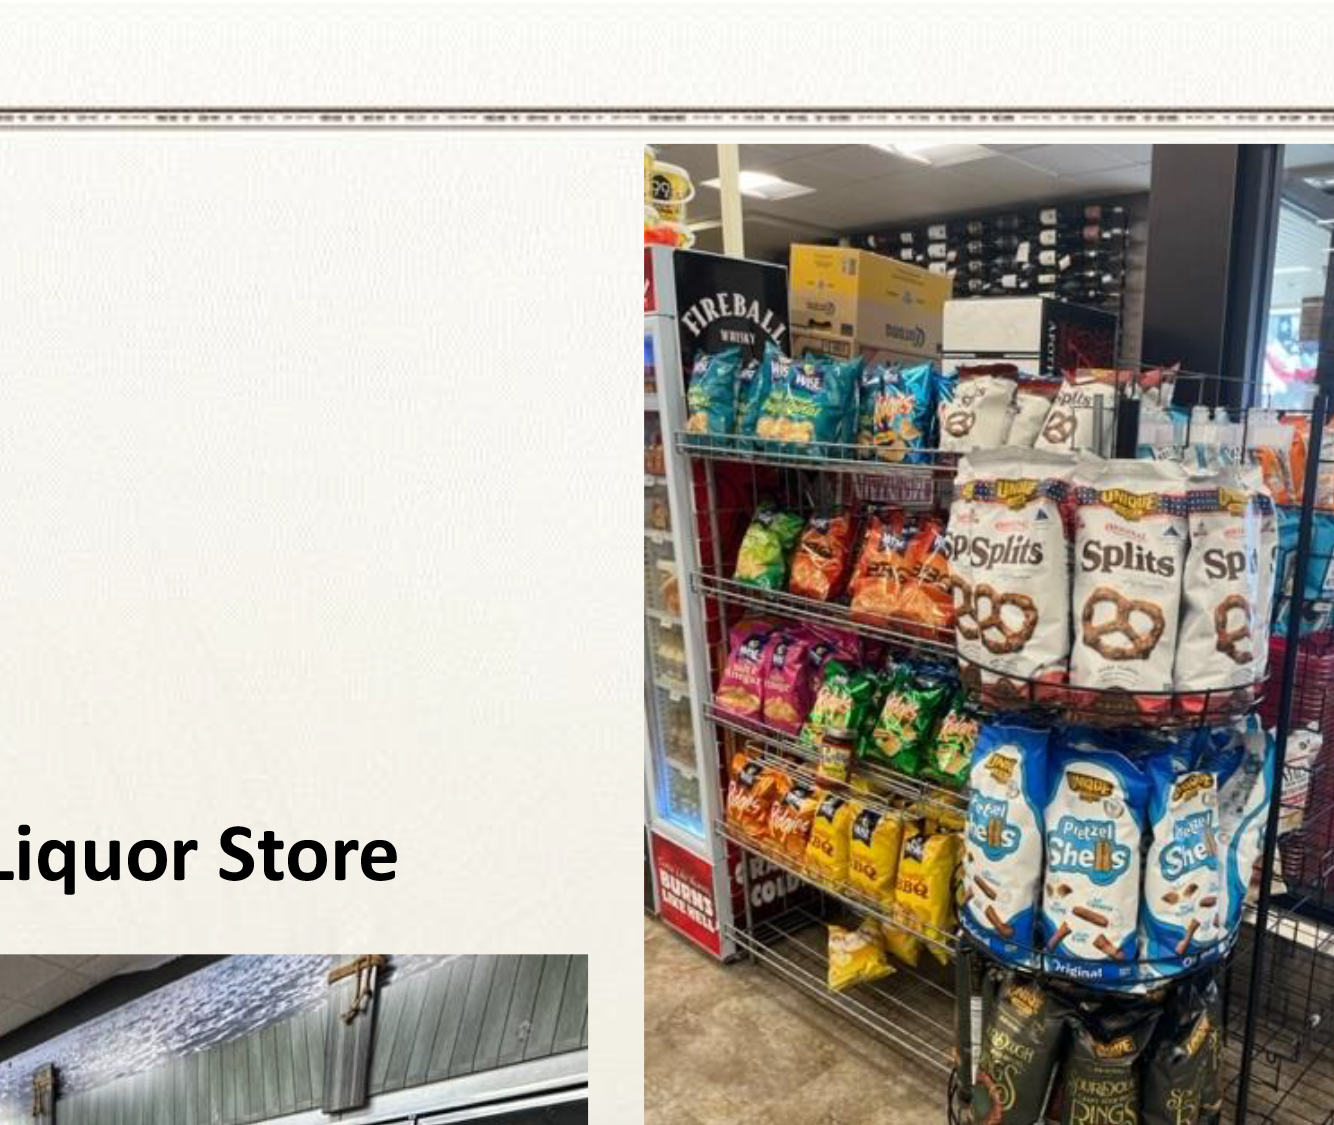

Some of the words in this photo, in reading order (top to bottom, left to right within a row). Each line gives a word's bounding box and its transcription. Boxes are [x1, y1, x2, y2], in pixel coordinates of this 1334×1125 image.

[681, 292, 790, 345] FIREBALL
[720, 328, 756, 346] WHISKY
[970, 533, 1044, 570] Splits
[1081, 538, 1175, 578] Splits
[1062, 819, 1113, 841] Pretzel
